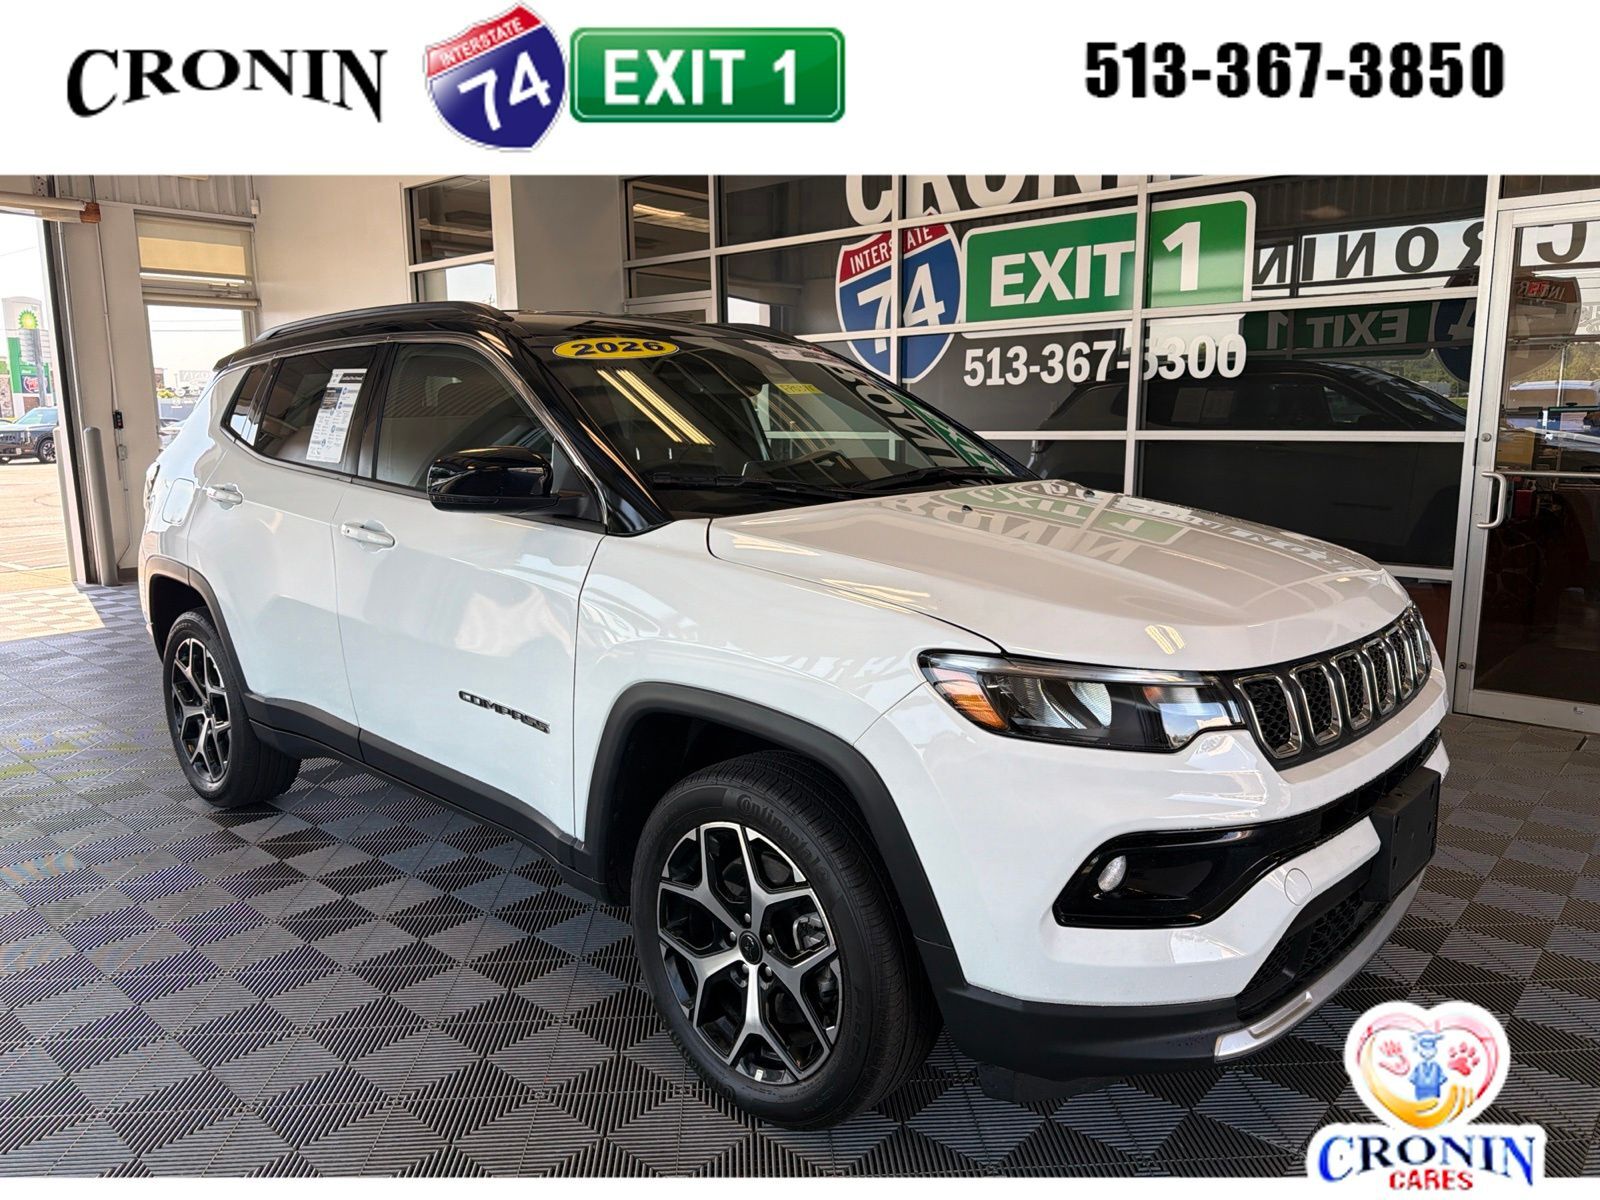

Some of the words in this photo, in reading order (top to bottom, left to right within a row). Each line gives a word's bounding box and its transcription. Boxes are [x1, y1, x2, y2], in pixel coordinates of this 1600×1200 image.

[850, 226, 934, 275] INTERATE
[990, 240, 1135, 308] EXIT
[1162, 222, 1202, 292] 1
[857, 262, 946, 354] 74
[571, 340, 664, 357] 2026
[459, 690, 551, 735] COMPASS
